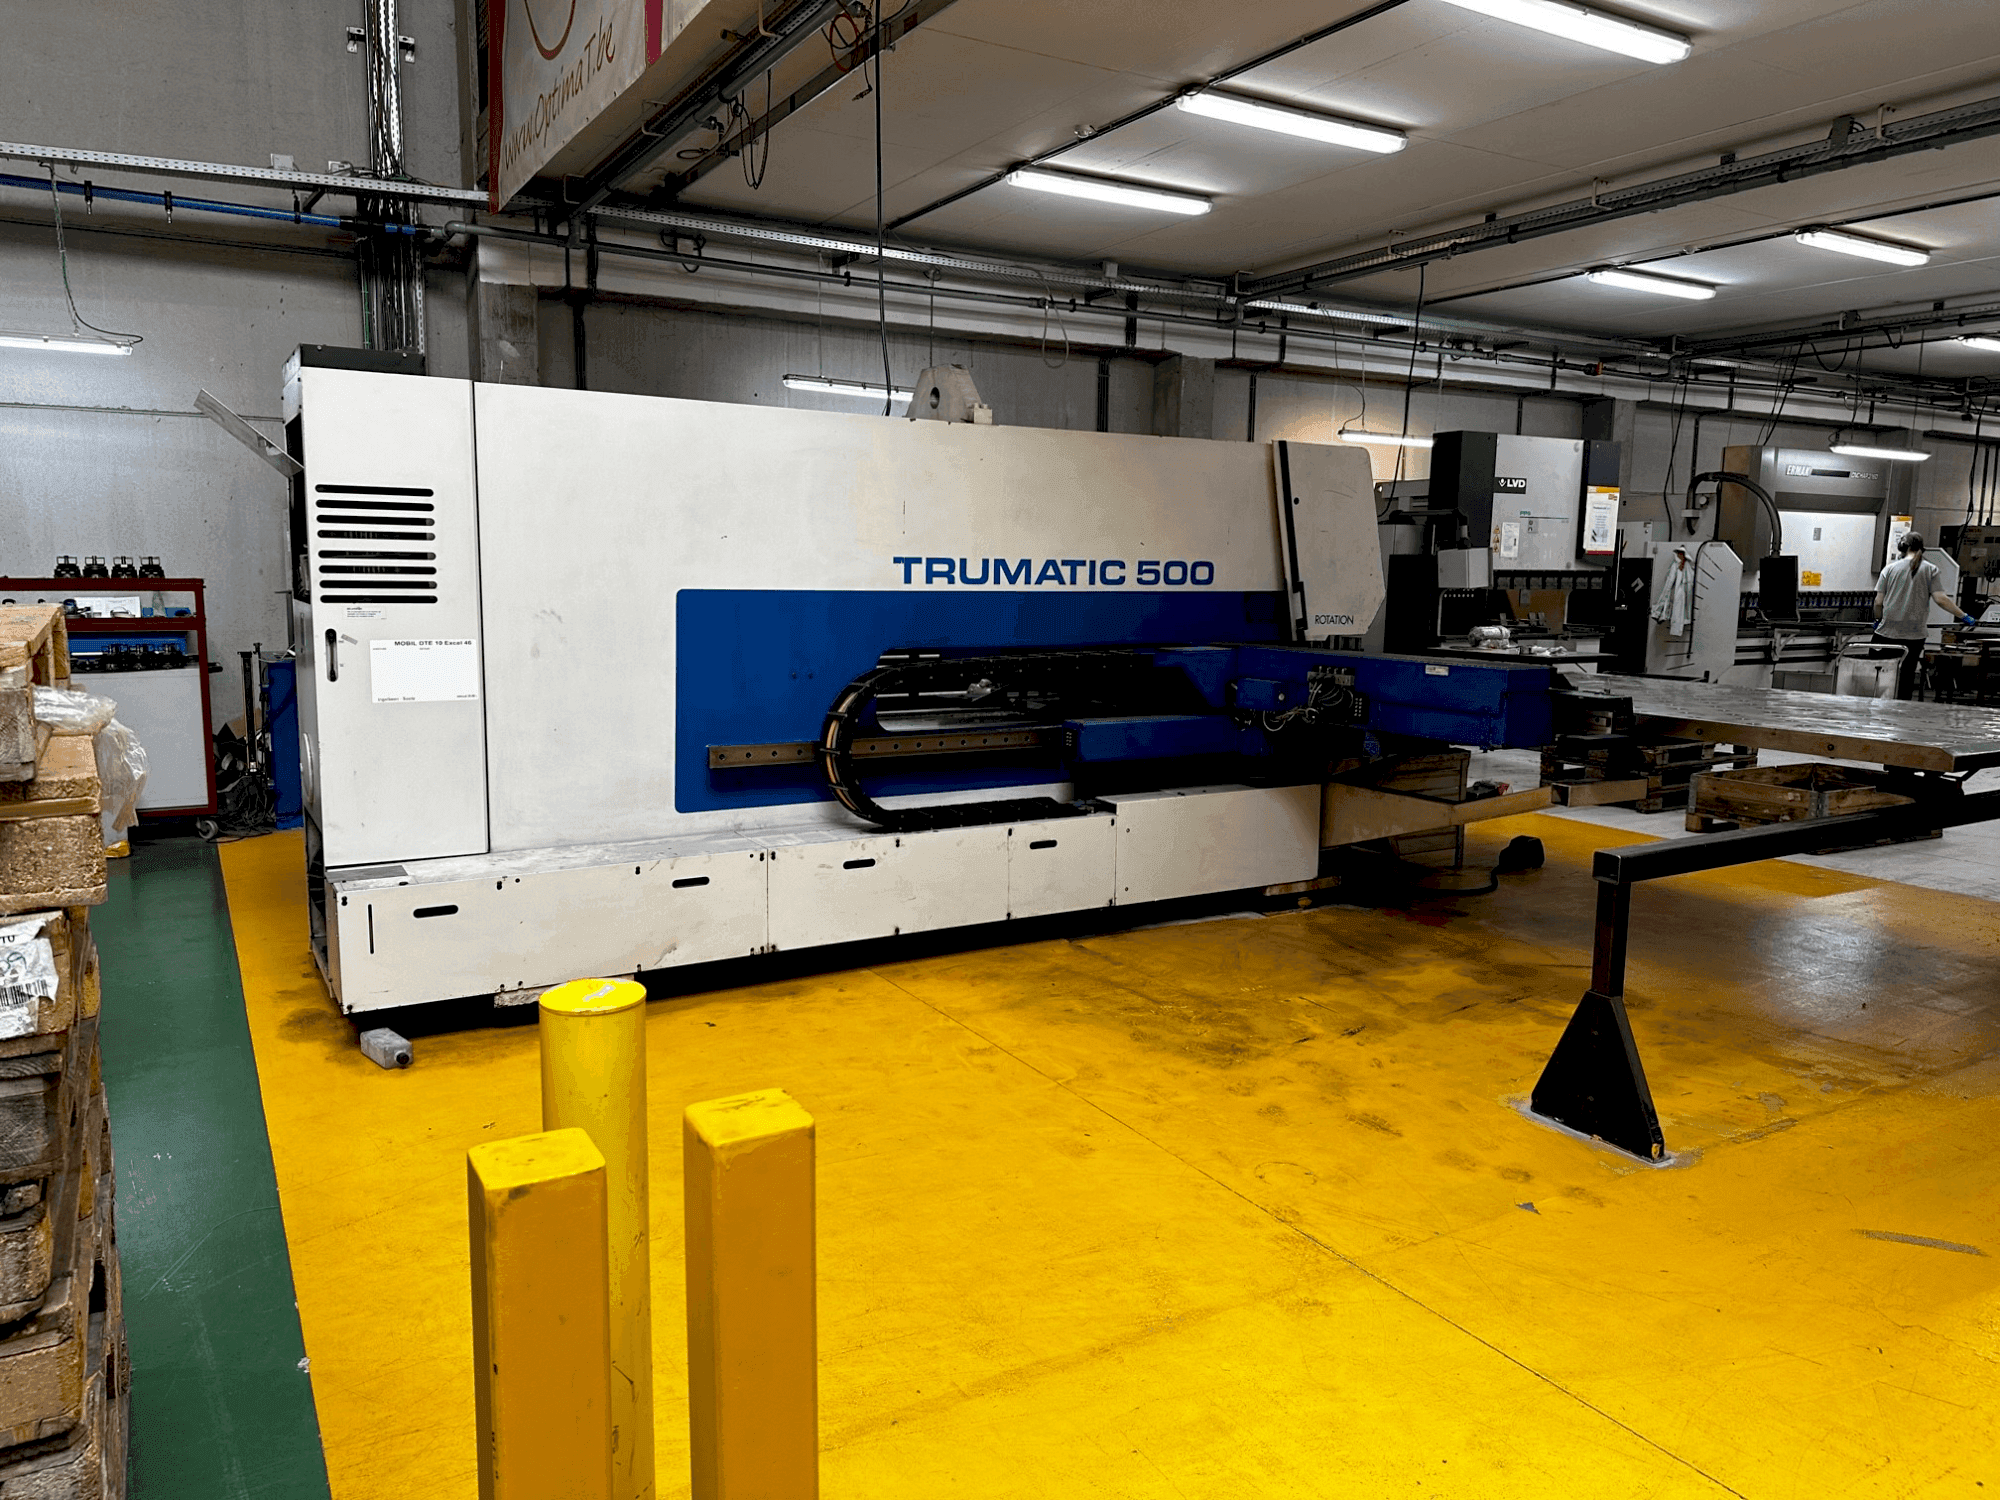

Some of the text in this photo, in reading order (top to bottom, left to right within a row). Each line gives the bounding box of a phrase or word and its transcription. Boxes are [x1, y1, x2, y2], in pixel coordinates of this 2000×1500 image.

[1506, 478, 1526, 488] LVD
[892, 556, 1216, 587] TRUMATIC 500
[1314, 614, 1355, 625] ROTATION
